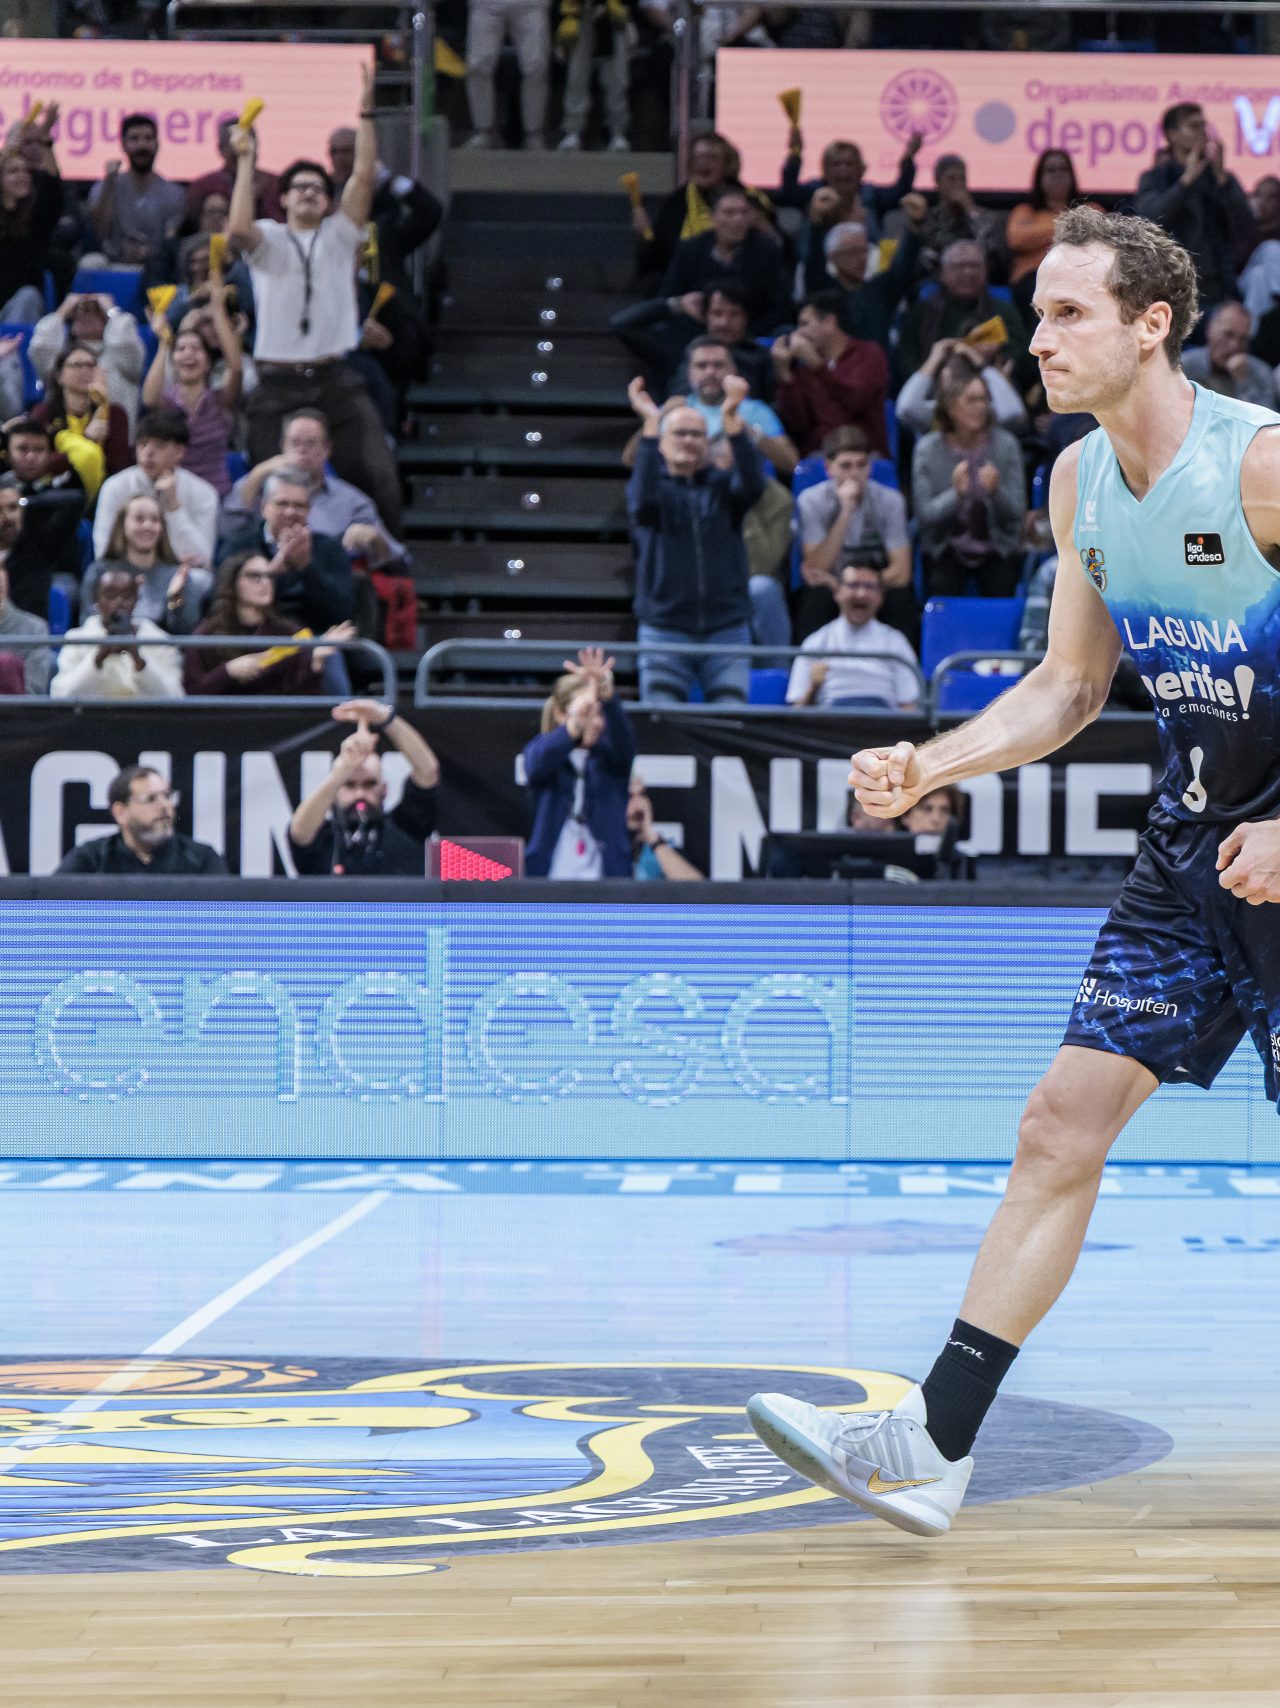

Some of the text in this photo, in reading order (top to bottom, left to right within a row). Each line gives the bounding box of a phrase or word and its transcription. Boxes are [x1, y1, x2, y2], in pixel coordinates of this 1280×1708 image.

[95, 66, 122, 89] de
[132, 69, 243, 92] Deportes
[1025, 79, 1159, 104] Organismo
[1187, 543, 1203, 554] liga
[1188, 552, 1223, 562] endesa
[1123, 616, 1249, 653] LAGUNA
[1179, 702, 1239, 722] emociones
[34, 926, 853, 1107] endesa
[1094, 989, 1178, 1018] Hospiten
[153, 1475, 792, 1549] LA LAGUNA
